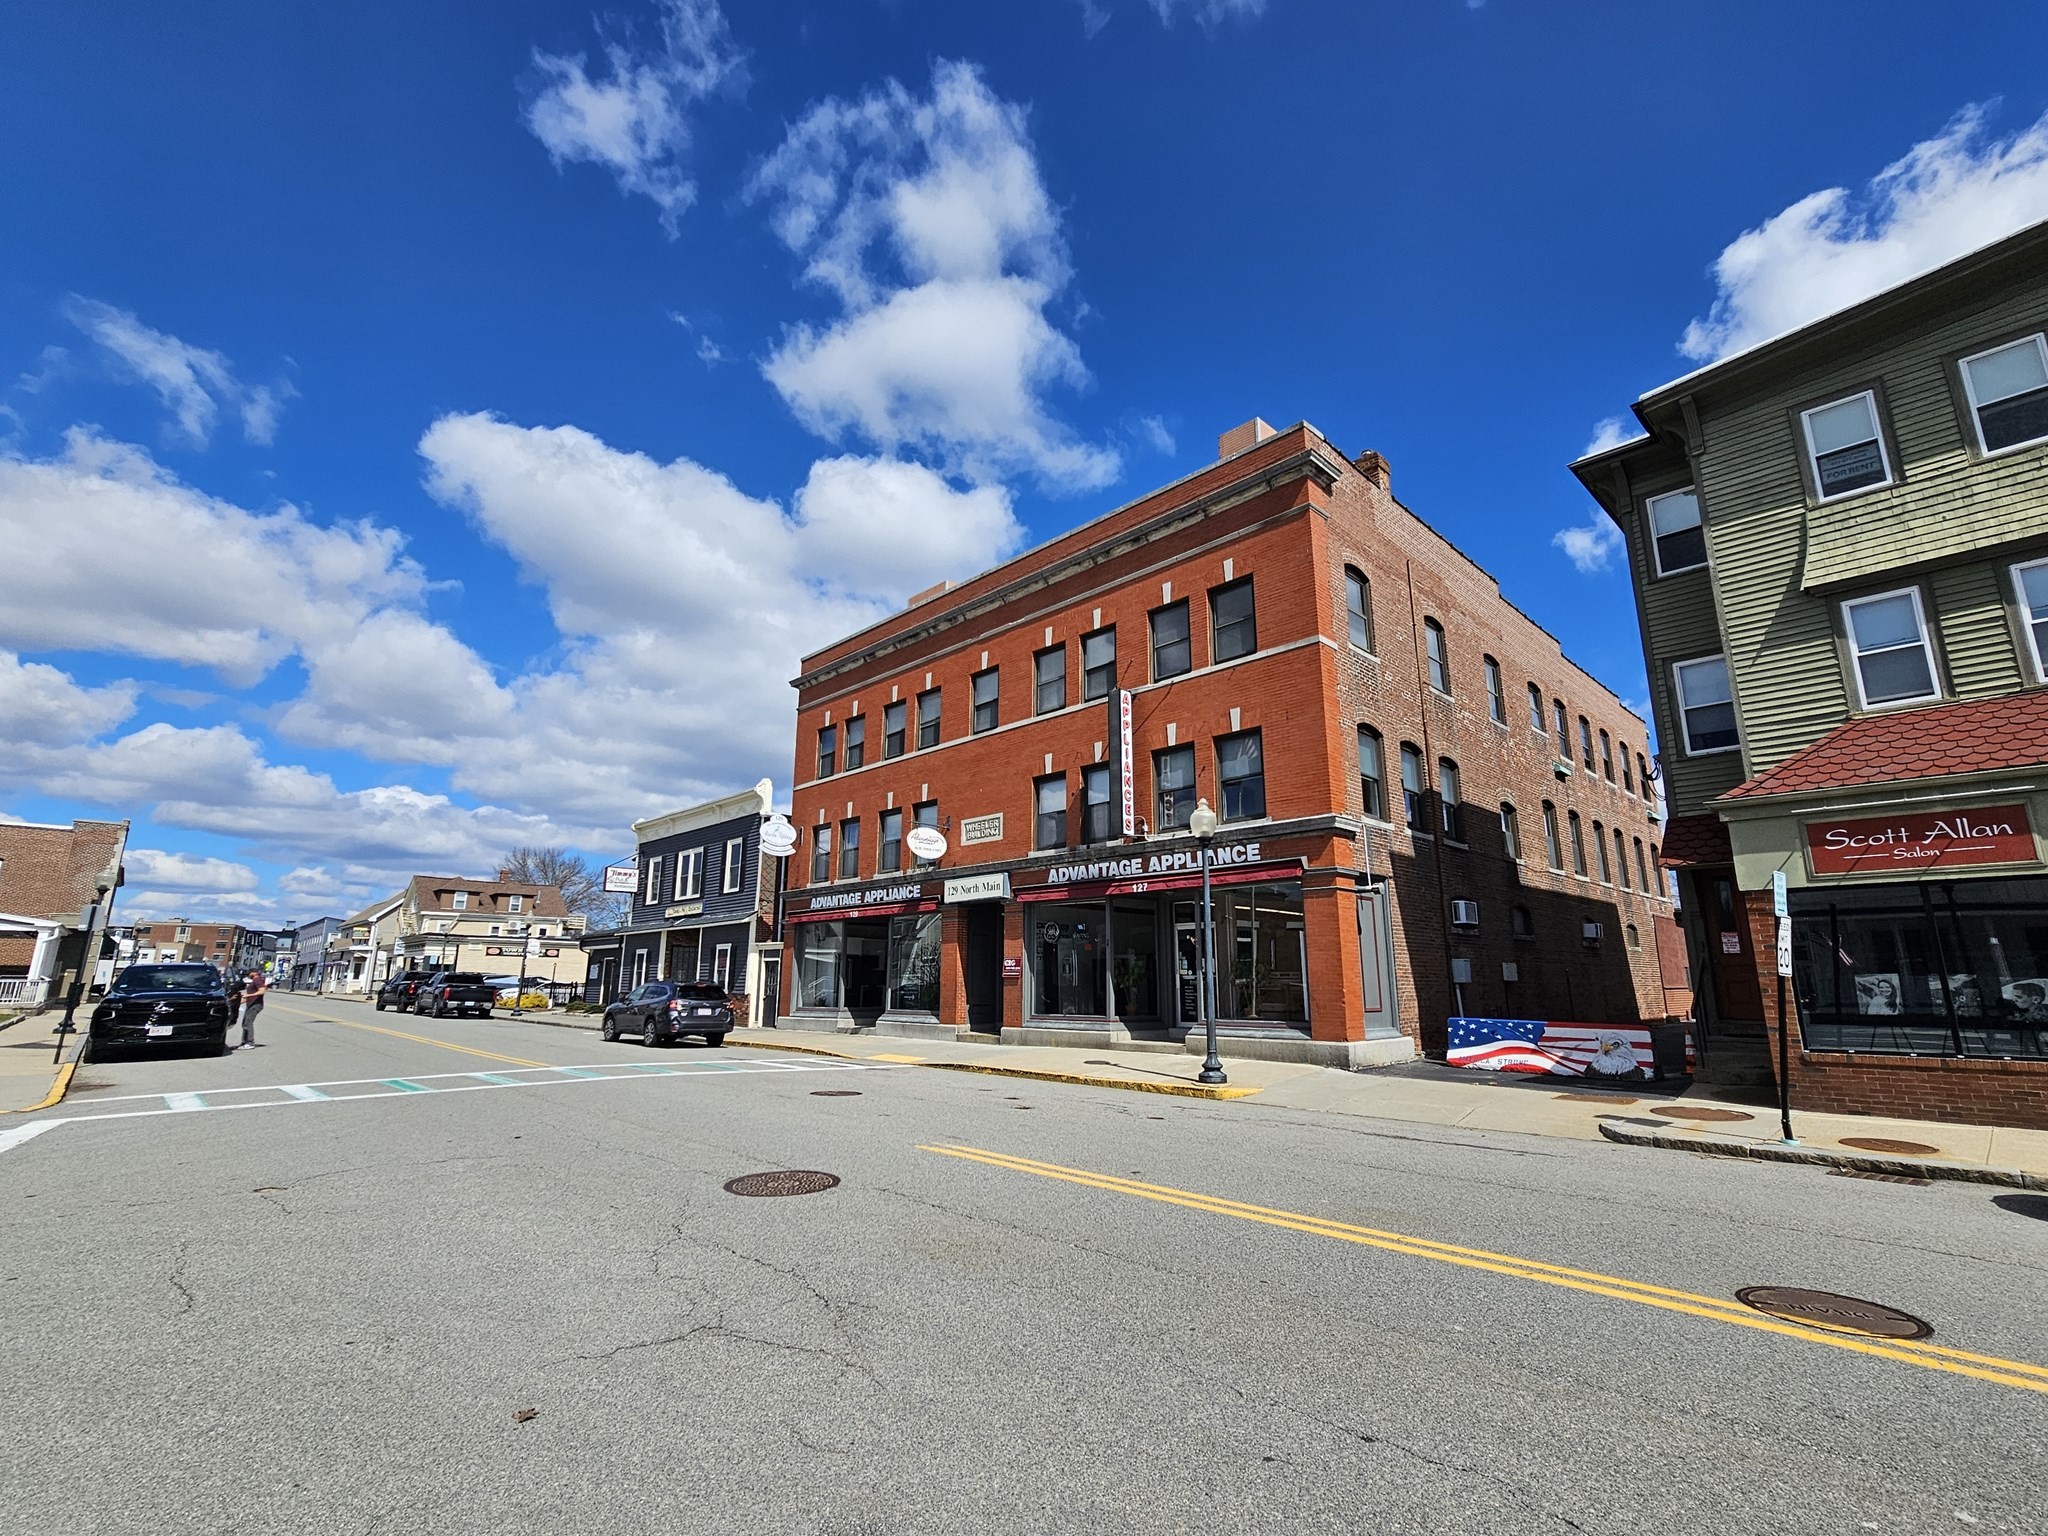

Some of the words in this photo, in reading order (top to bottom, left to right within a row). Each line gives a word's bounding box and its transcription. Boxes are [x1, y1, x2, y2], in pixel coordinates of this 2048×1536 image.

[1826, 469, 1847, 479] FOR
[1848, 461, 1875, 475] RENT
[1122, 693, 1132, 831] APPLIANCES
[966, 819, 999, 832] WHEELER
[1824, 827, 1910, 850] Scott
[1921, 817, 2013, 844] Allan
[1893, 846, 1940, 859] Salon
[1048, 858, 1143, 884] ADVANTAGE
[1149, 843, 1261, 873] APPLIANCE
[810, 892, 862, 909] ADVANTAGE
[864, 885, 921, 903] APPLIANCE
[947, 886, 959, 897] 129
[960, 884, 980, 895] North
[981, 880, 1001, 892] Main
[1131, 883, 1148, 893] 127
[1779, 947, 1790, 968] 20
